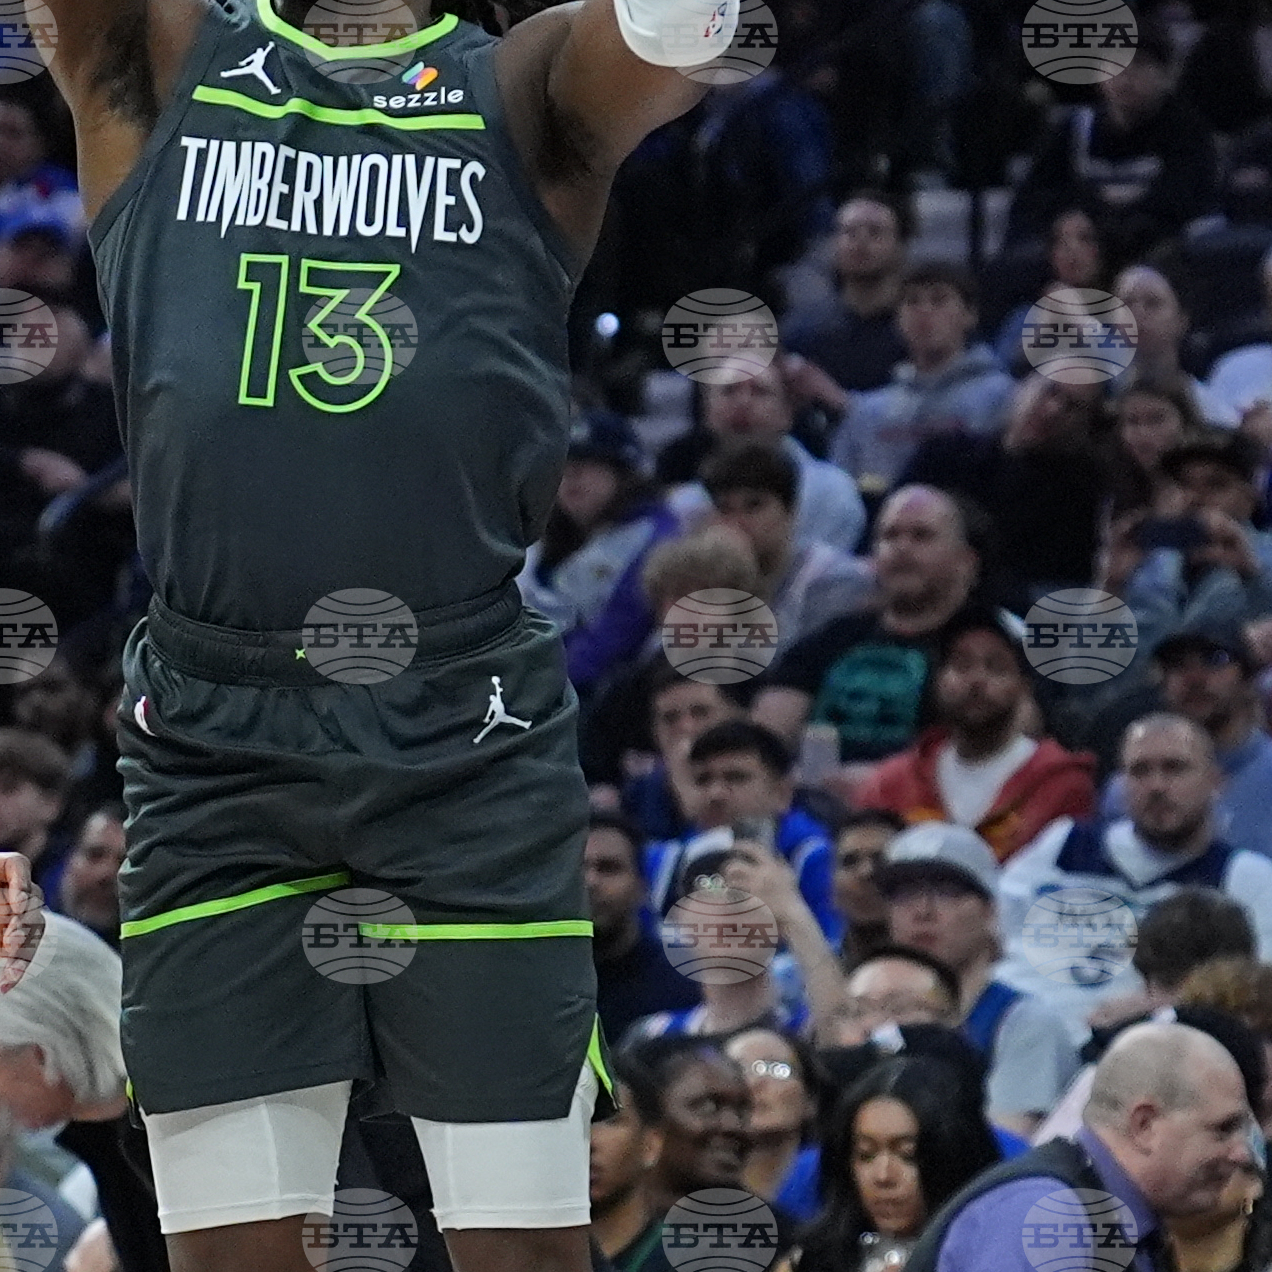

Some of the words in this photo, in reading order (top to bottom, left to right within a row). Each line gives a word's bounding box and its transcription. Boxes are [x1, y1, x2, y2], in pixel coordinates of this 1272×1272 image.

[373, 86, 464, 109] sezzle
[177, 135, 487, 254] TIMBERWOLVES
[237, 252, 401, 414] 13
